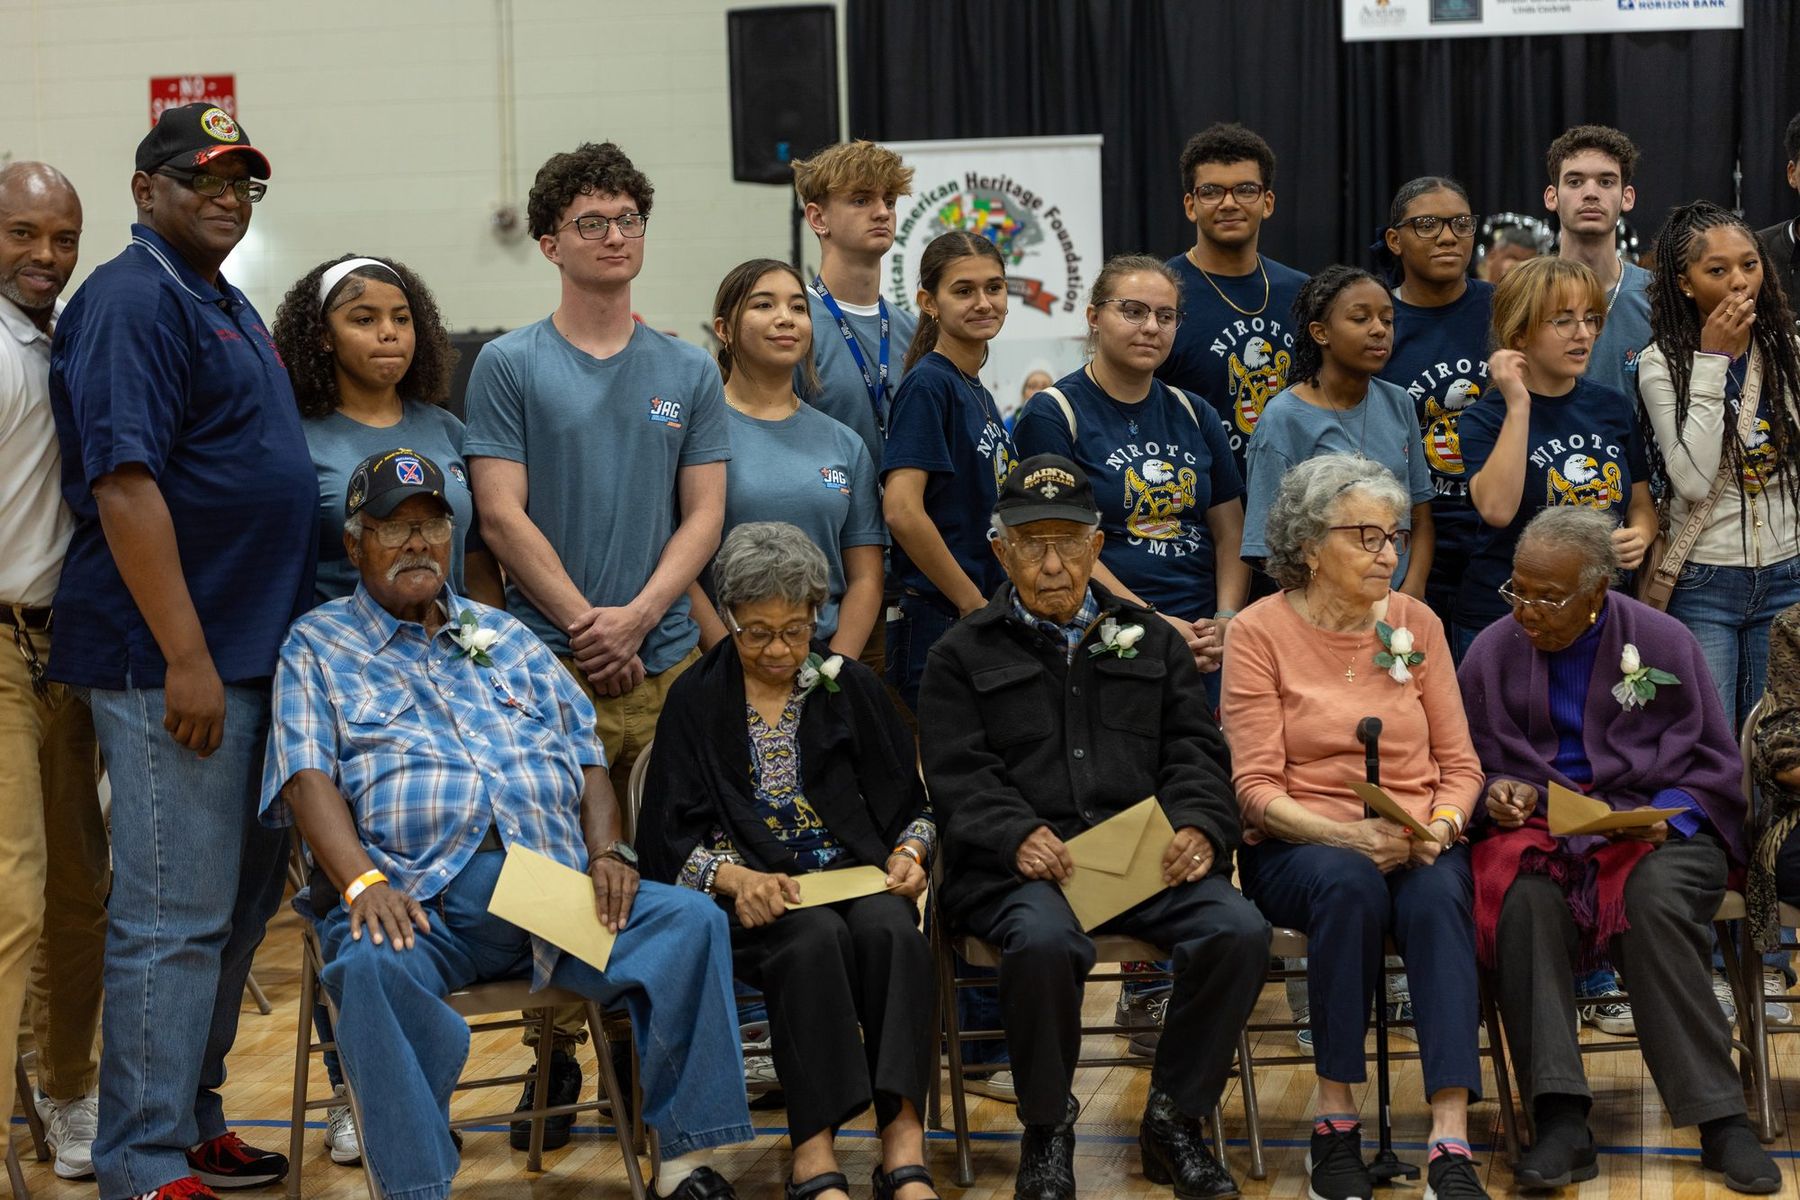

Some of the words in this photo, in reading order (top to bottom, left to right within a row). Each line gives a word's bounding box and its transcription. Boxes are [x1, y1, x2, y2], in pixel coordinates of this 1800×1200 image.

[179, 76, 205, 97] NO
[894, 179, 959, 247] American
[965, 171, 1043, 209] Heritage
[1044, 205, 1084, 313] Foundation
[1210, 317, 1294, 357] NJROTC
[1407, 359, 1490, 400] NJROT
[651, 400, 680, 419] JAG
[977, 423, 1019, 459] NJROT
[1106, 441, 1197, 471] NJROTC
[1530, 434, 1620, 469] NJROTC
[824, 469, 847, 485] JAG
[1024, 467, 1075, 485] SAINTS
[1679, 514, 1702, 549] POLO
